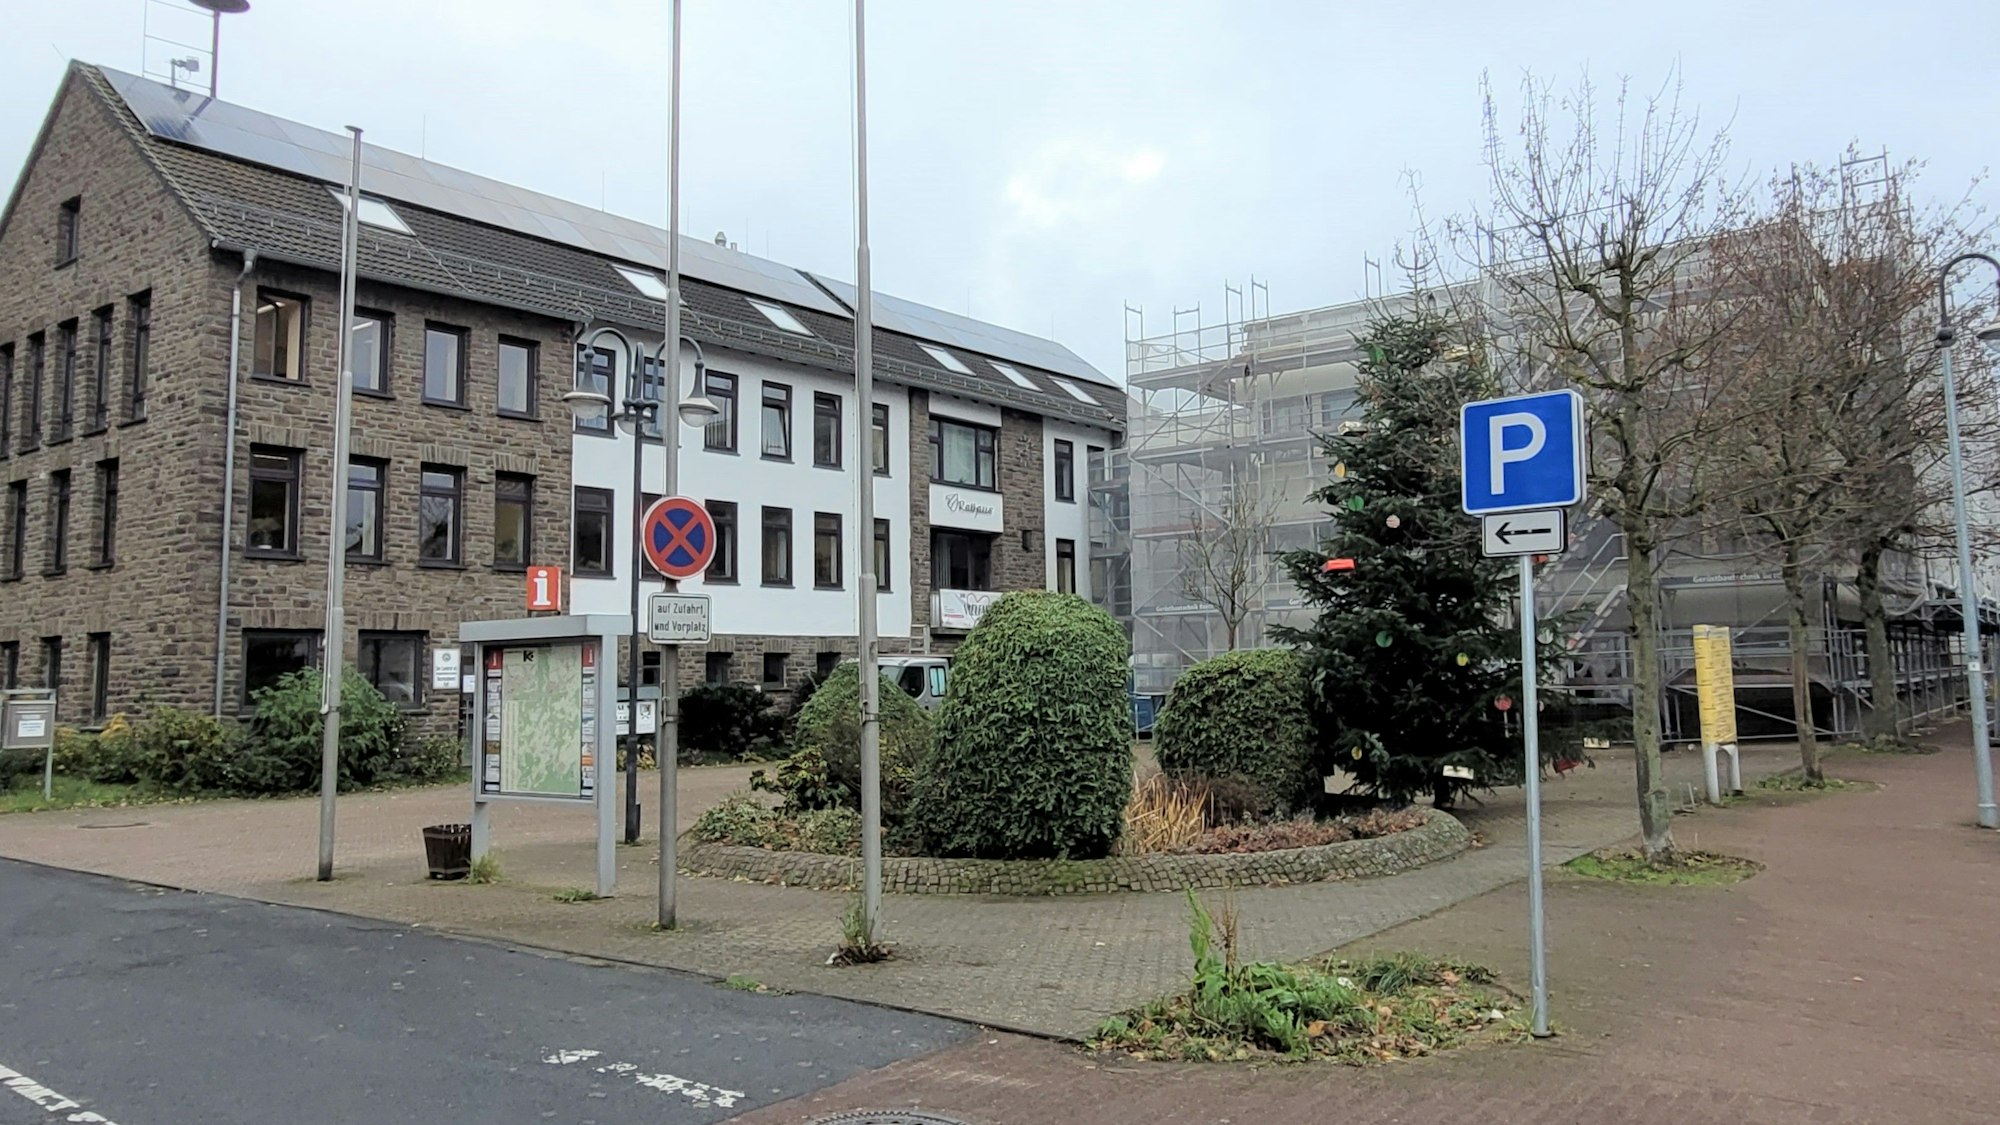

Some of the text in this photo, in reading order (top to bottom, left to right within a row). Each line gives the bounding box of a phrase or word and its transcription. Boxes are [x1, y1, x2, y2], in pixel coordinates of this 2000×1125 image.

[1489, 412, 1547, 495] P
[958, 500, 994, 518] Rathaus
[533, 570, 551, 605] i
[657, 602, 703, 614] auf Zufahrt
[655, 620, 706, 634] und Vorplatz
